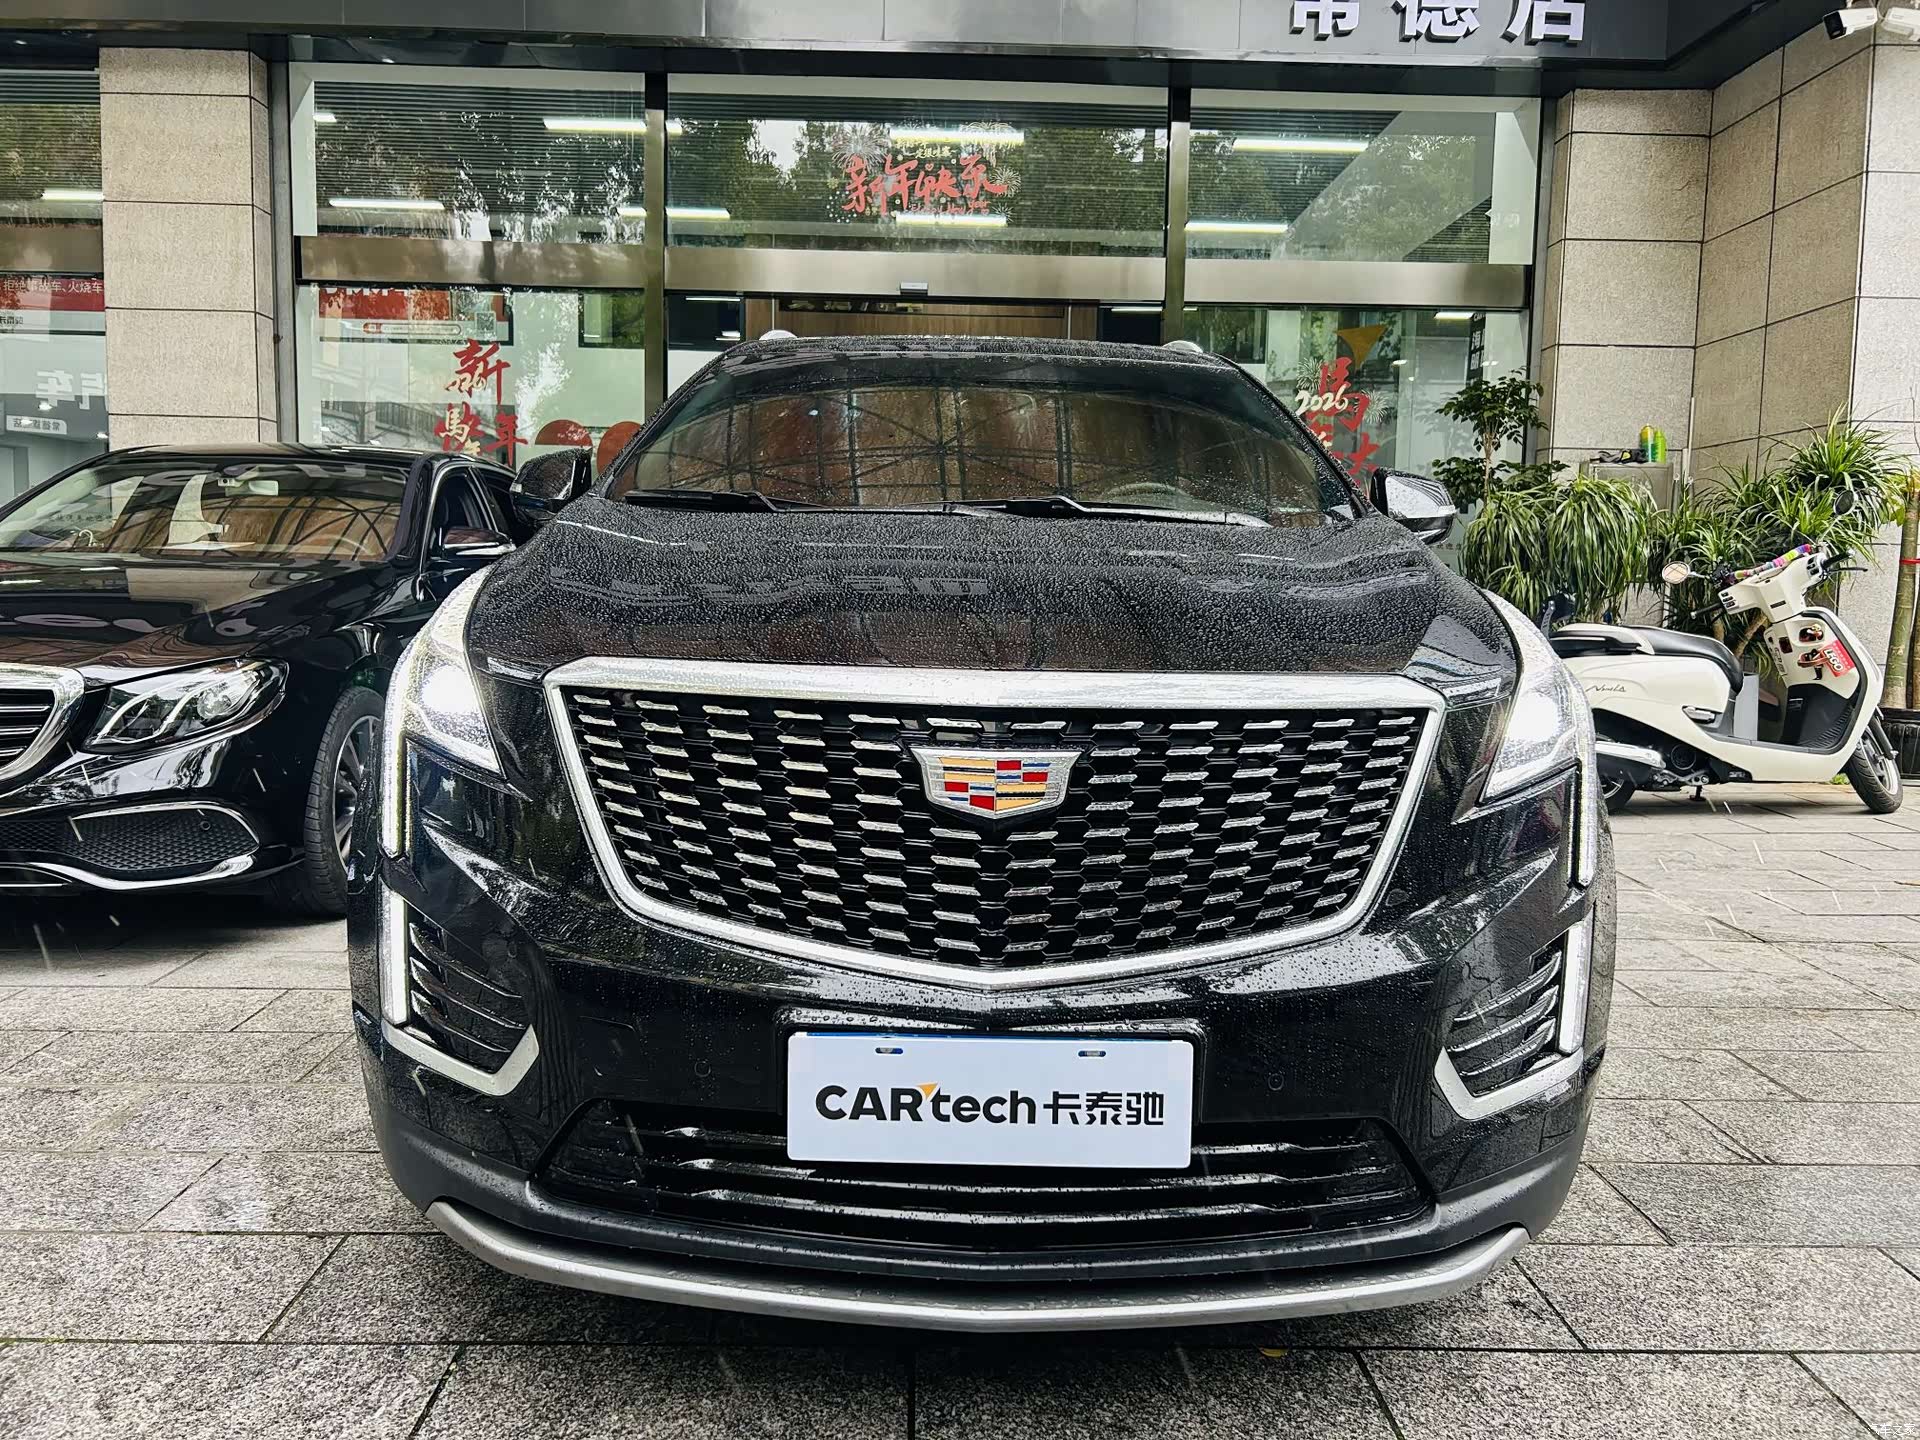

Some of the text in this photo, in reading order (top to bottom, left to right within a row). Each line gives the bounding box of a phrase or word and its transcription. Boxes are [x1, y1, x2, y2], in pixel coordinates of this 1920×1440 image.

[1295, 384, 1349, 416] 2026
[1823, 648, 1844, 671] LEGO
[815, 1083, 1164, 1126] CARtech 卡泰驰
